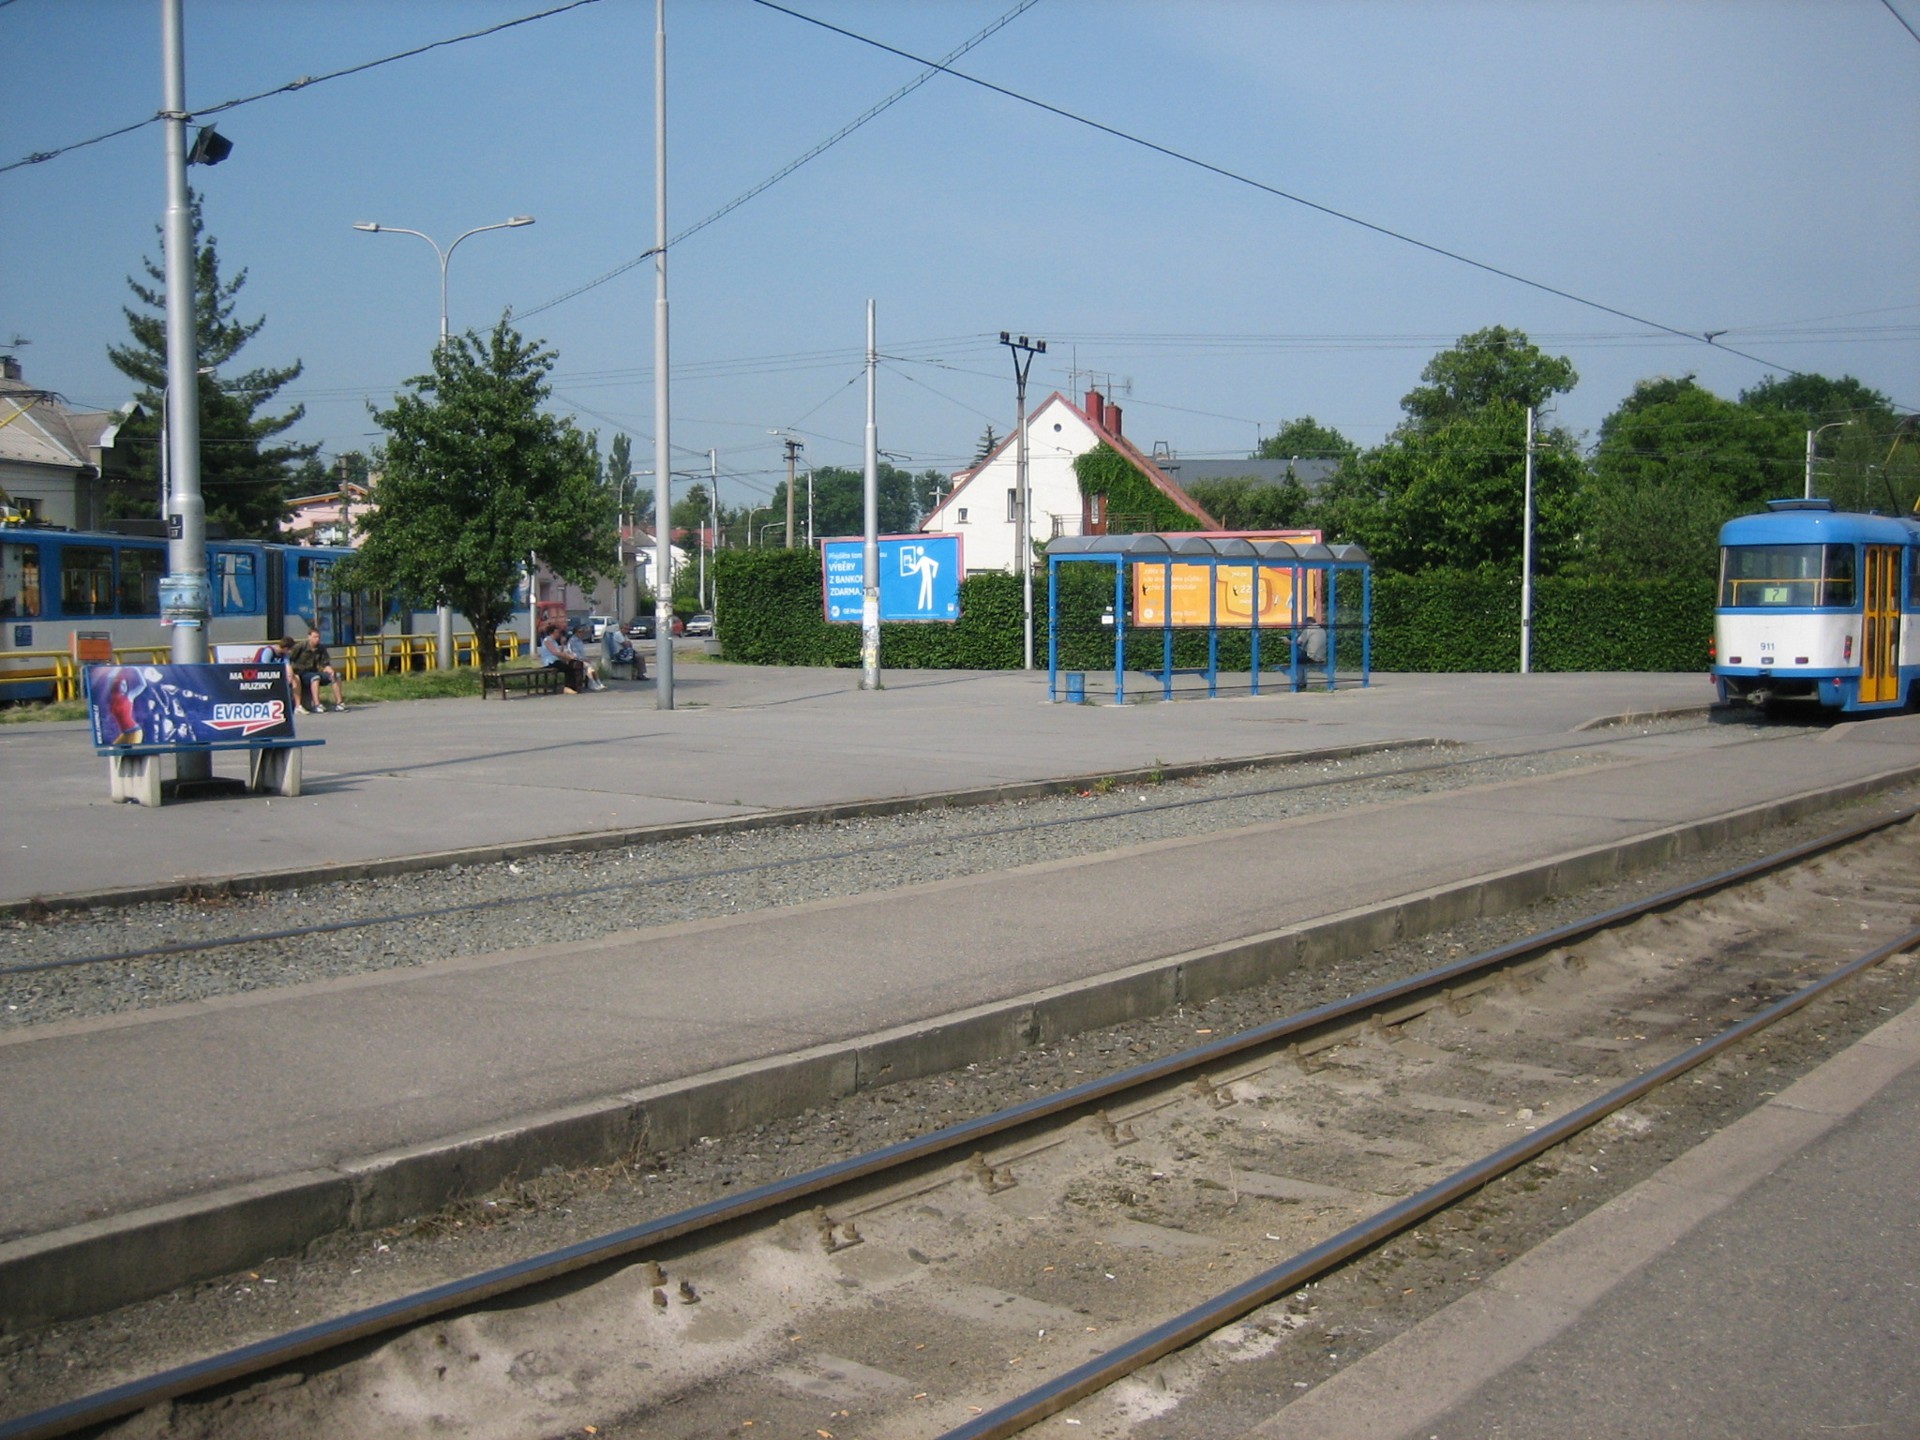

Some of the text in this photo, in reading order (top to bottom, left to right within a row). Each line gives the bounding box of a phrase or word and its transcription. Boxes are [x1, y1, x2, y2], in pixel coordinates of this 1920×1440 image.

[828, 561, 856, 572] VÝBĚRY
[829, 575, 835, 584] Z
[1772, 589, 1780, 601] 7
[1760, 642, 1775, 651] 911
[229, 669, 281, 681] MAXXIMUM
[239, 682, 273, 691] MUZIKY
